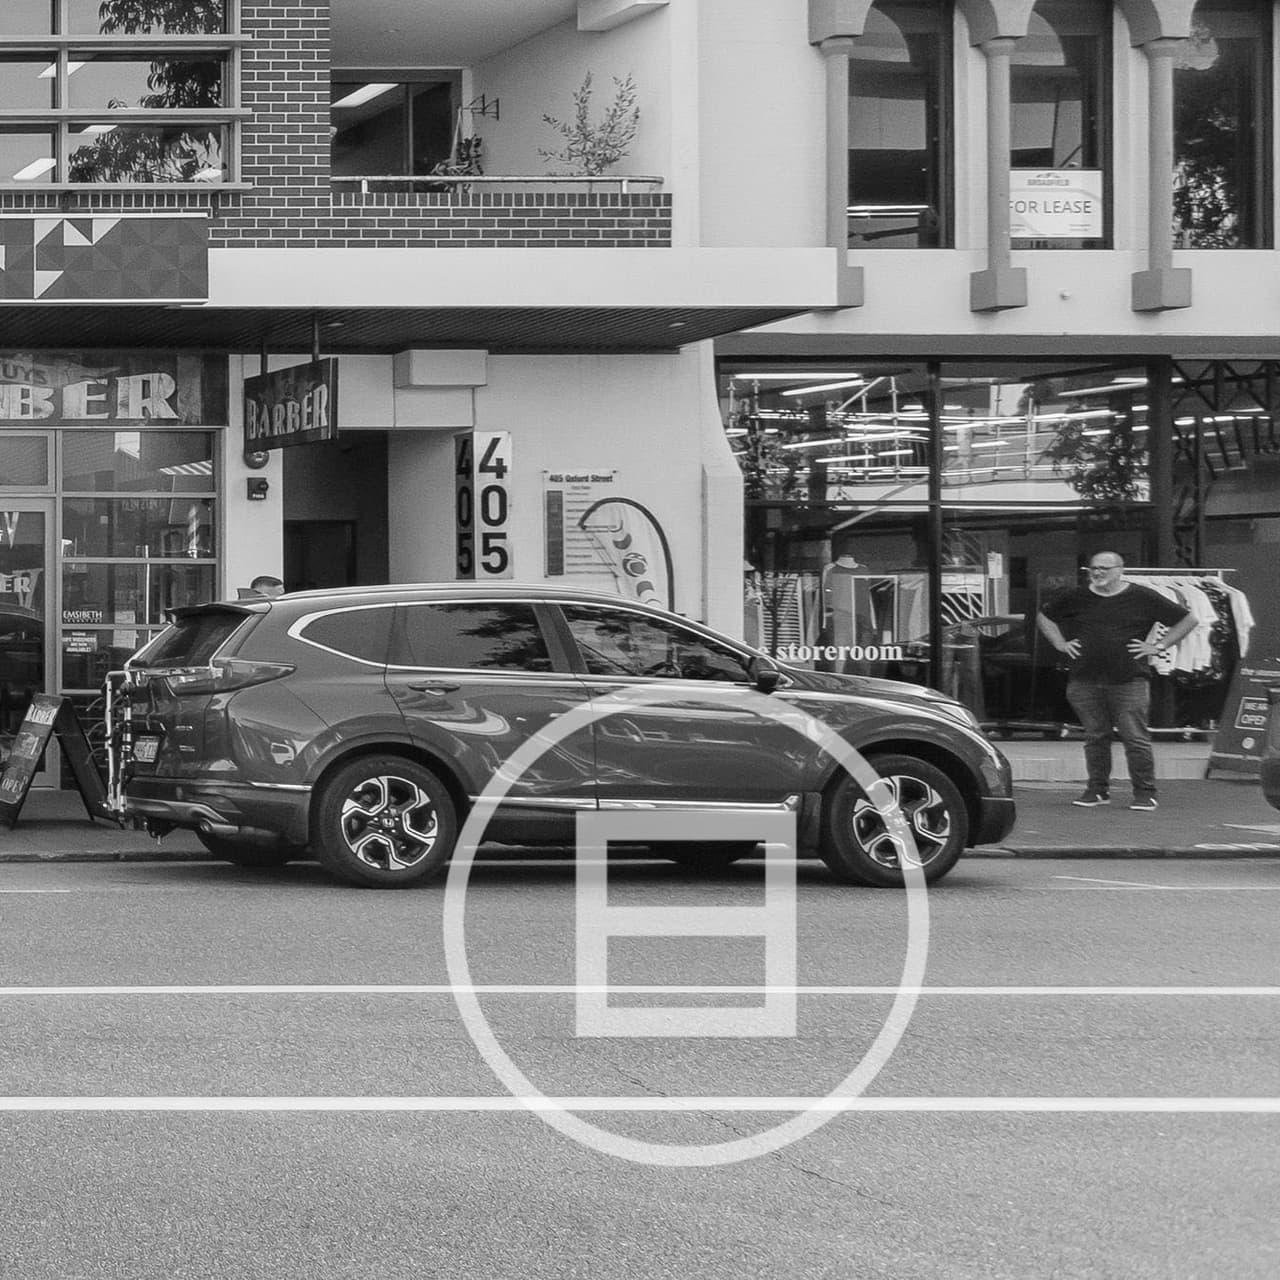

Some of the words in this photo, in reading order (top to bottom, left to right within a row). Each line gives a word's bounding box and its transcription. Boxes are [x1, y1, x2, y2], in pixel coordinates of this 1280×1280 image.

[1043, 200, 1092, 214] LEASE
[245, 383, 328, 440] BARBER
[565, 473, 589, 482] Oxford
[591, 474, 613, 482] Street
[456, 438, 473, 575] 405
[478, 436, 509, 574] 405
[63, 610, 103, 619] EMSIBETH
[776, 642, 903, 661] storeroom
